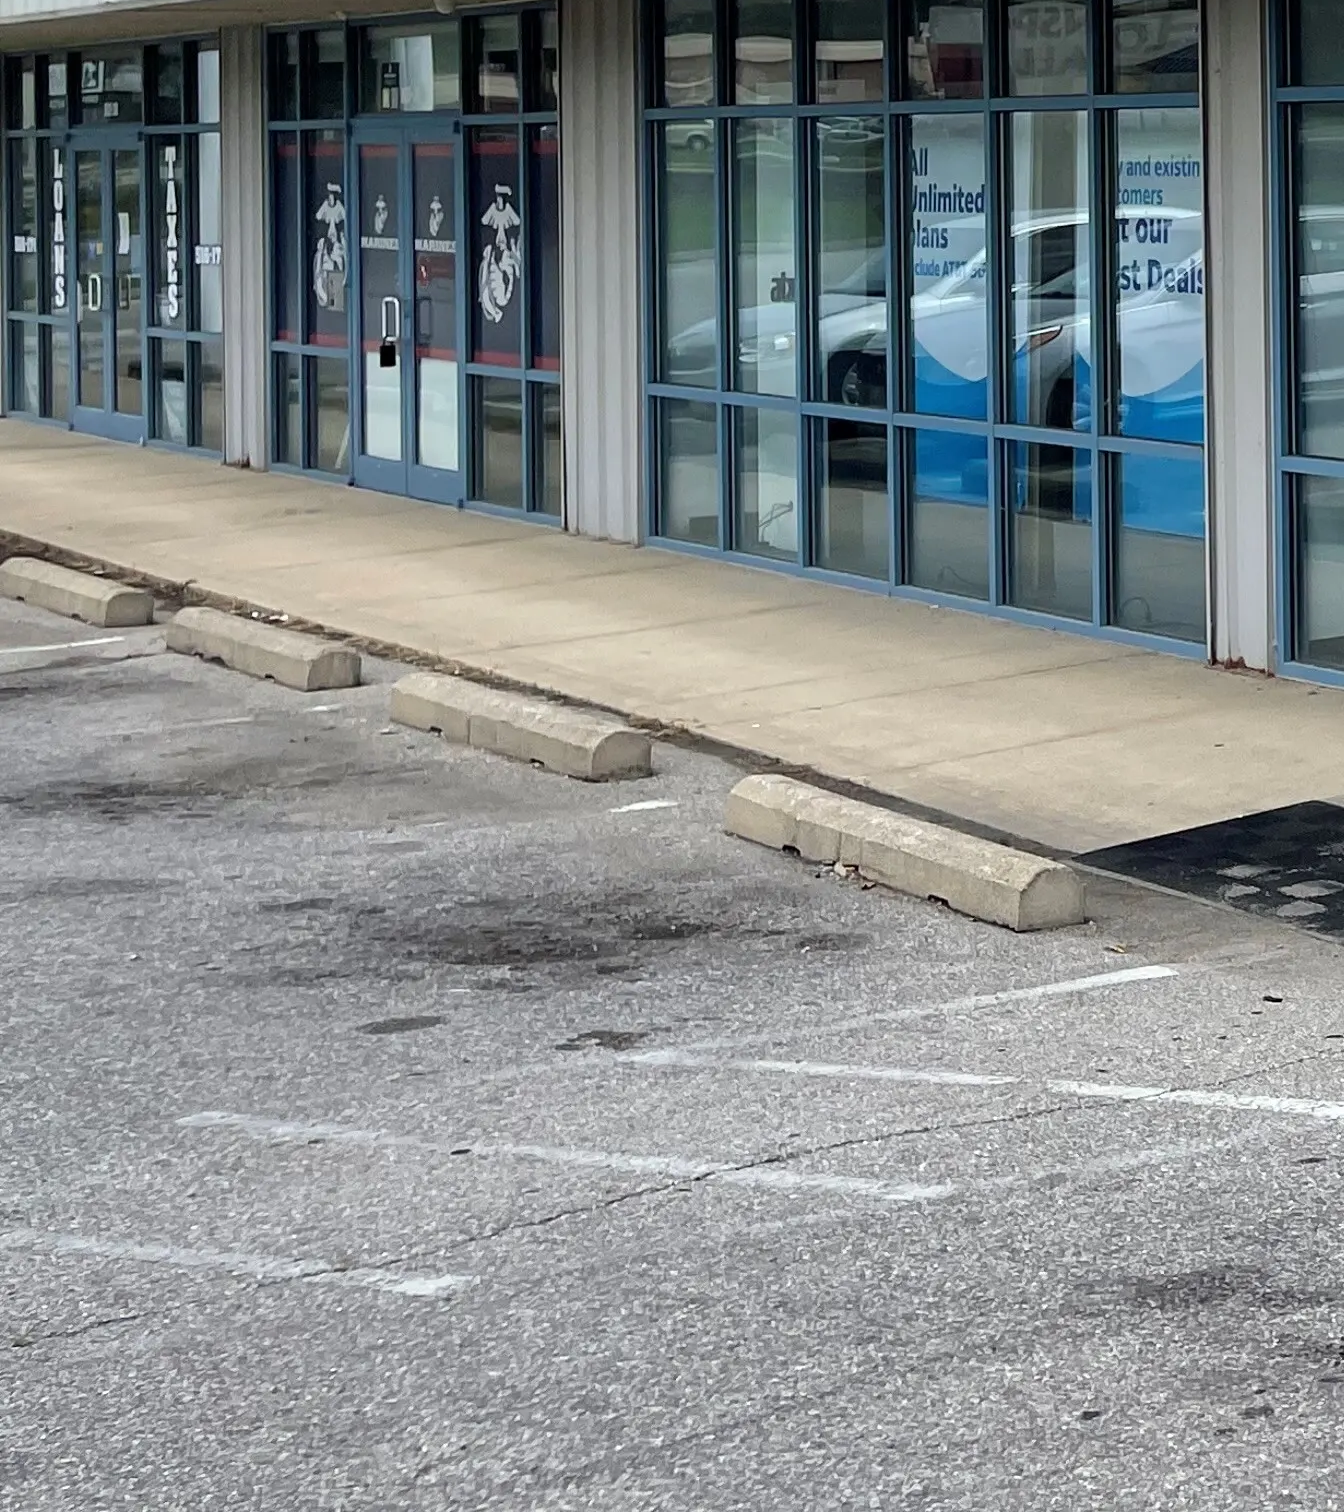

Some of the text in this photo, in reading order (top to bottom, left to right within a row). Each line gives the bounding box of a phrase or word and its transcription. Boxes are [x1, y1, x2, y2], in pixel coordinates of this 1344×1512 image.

[1126, 155, 1150, 177] and
[1154, 154, 1200, 178] existin
[1119, 189, 1163, 206] omers
[54, 149, 65, 307] LOANS
[165, 146, 178, 318] TAXES
[1136, 218, 1172, 244] our
